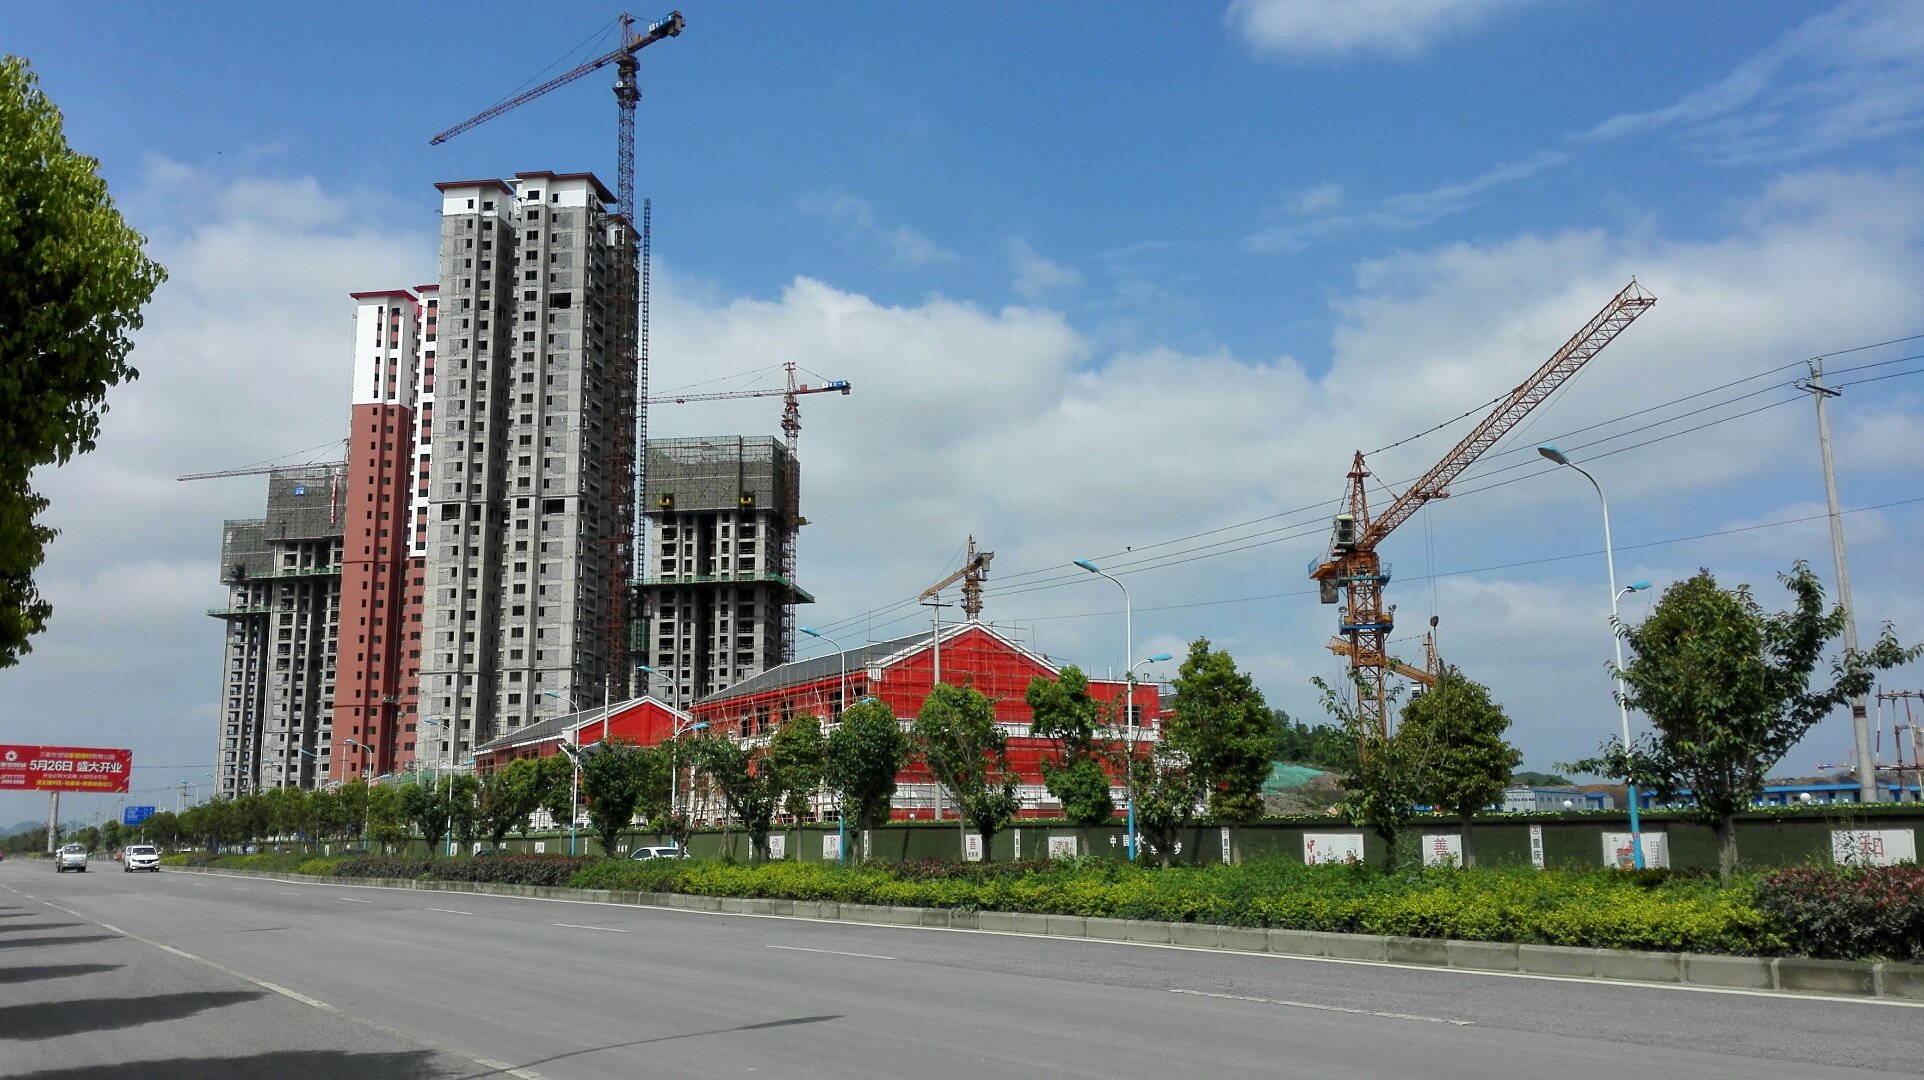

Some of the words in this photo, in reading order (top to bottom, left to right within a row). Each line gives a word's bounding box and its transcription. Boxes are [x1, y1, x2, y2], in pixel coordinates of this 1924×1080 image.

[29, 760, 73, 772] 5月26日
[76, 761, 122, 773] 盛大开业
